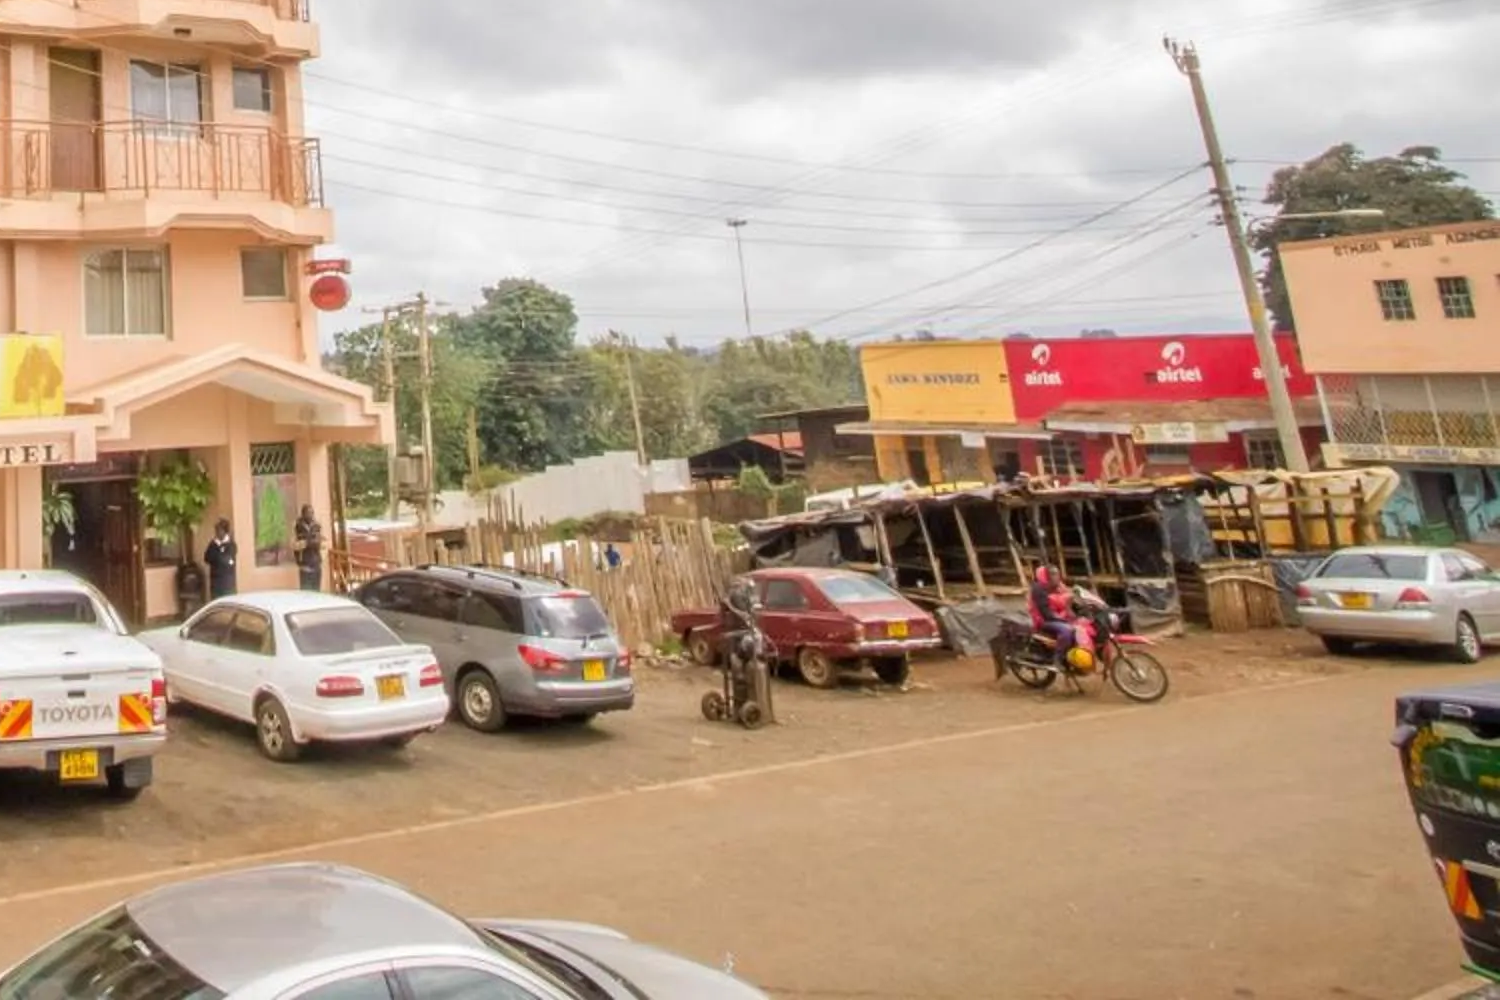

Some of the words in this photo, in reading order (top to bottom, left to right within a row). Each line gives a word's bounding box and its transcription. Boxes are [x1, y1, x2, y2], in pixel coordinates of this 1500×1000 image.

[1024, 371, 1063, 386] airtel
[1157, 366, 1203, 384] airtel
[40, 704, 114, 724] TOYOTA
